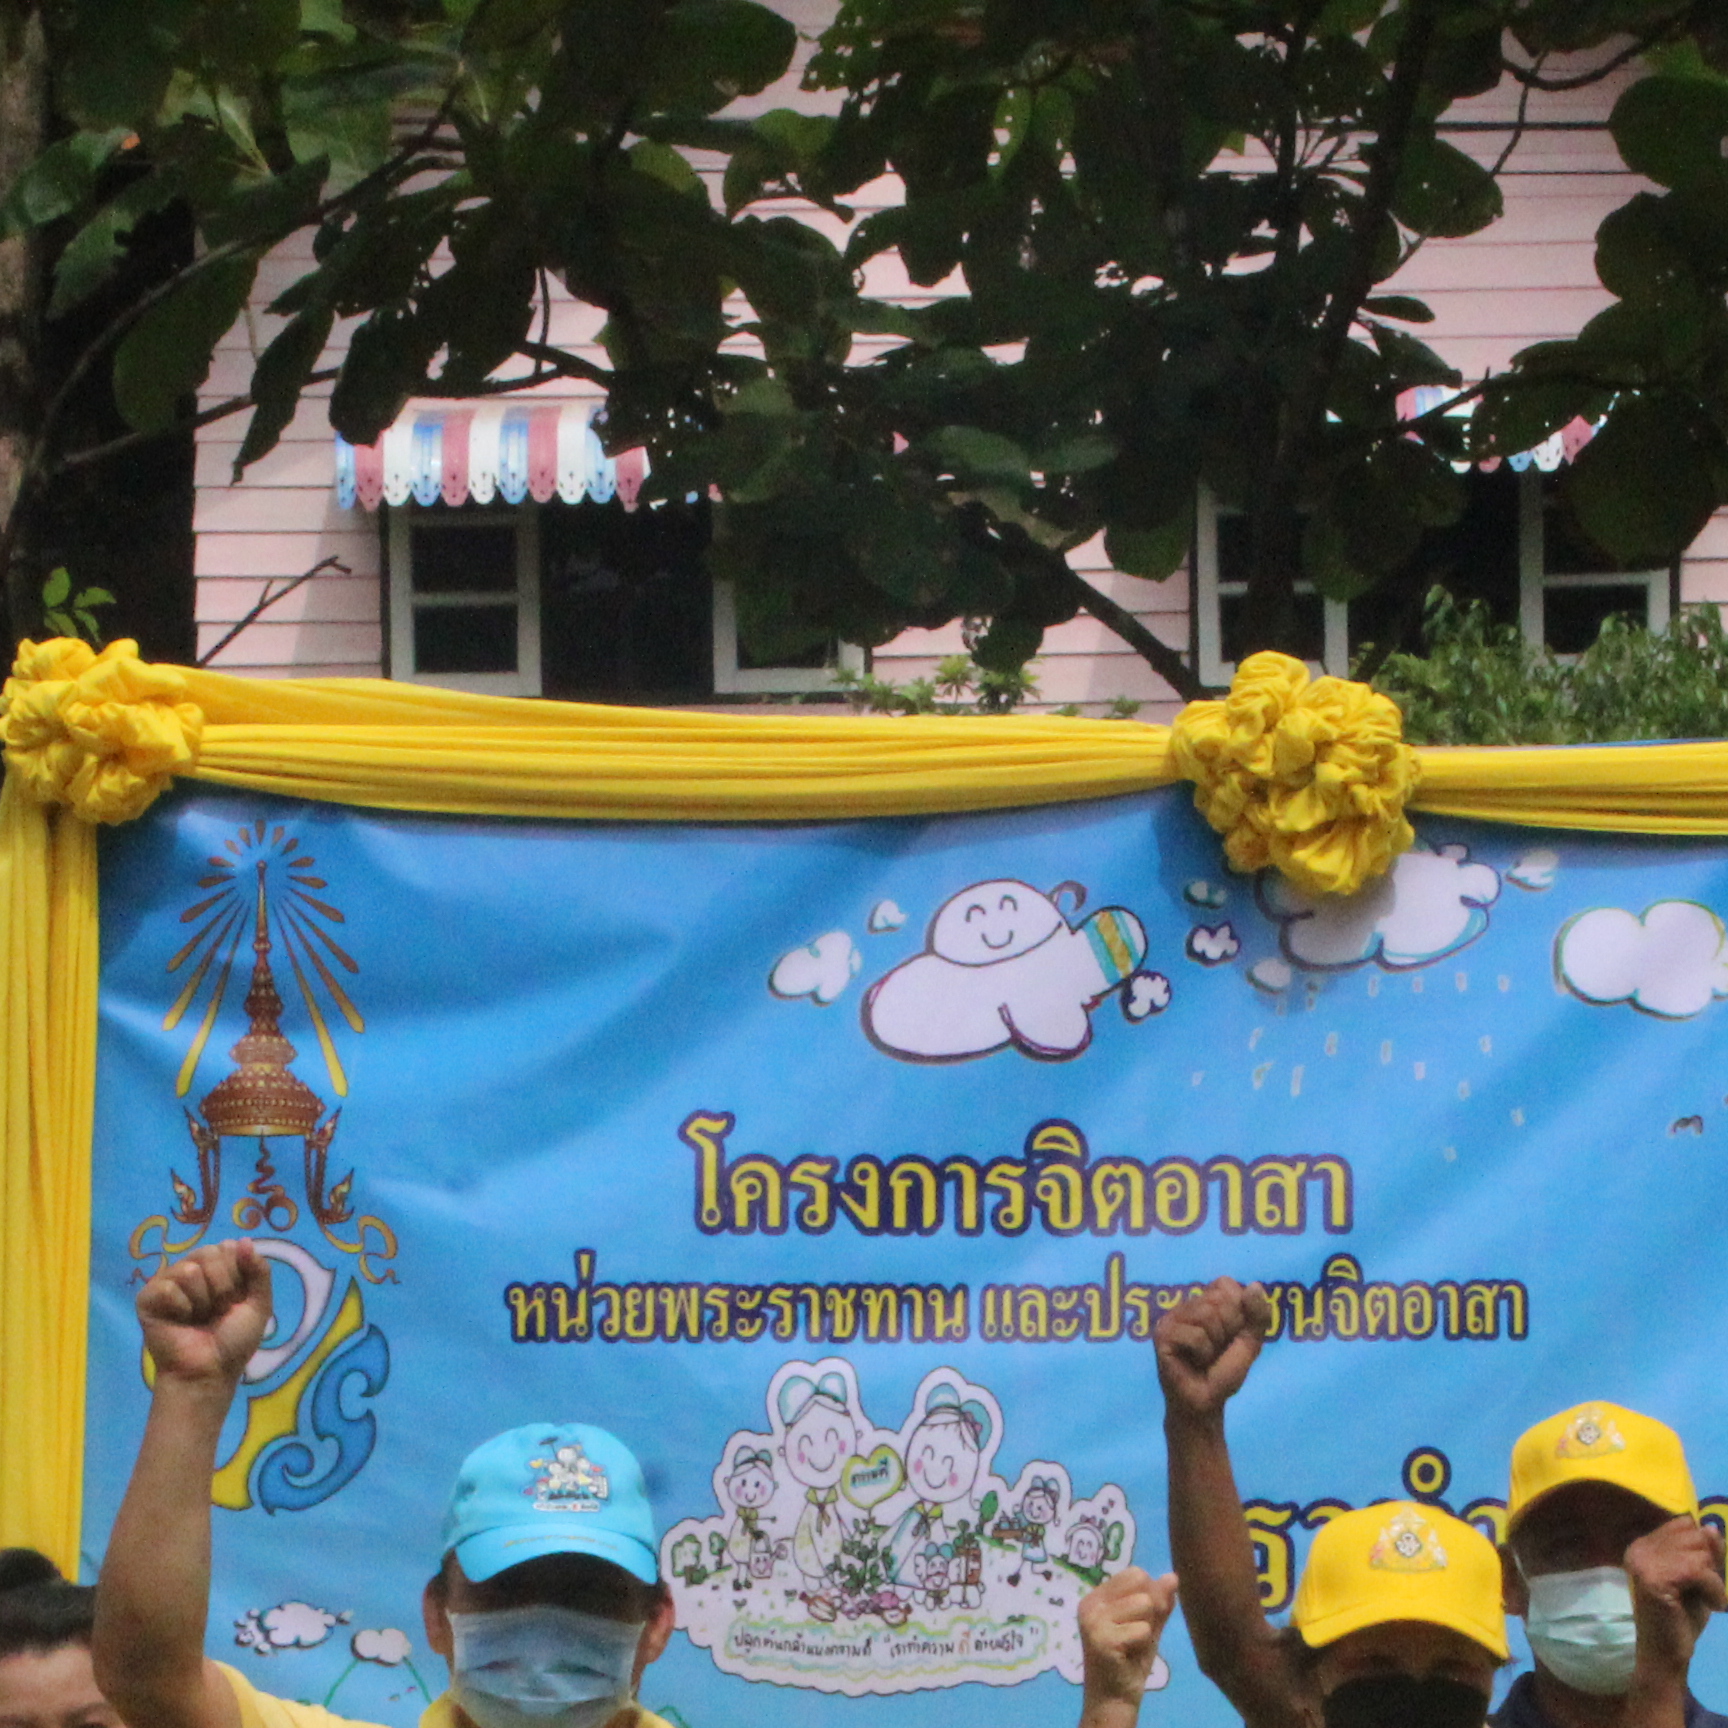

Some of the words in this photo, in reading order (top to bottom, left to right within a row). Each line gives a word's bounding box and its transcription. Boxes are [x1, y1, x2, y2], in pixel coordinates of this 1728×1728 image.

[679, 1111, 1355, 1239] โครงการจิตอาสา
[503, 1249, 969, 1346] หน่วยพระราชทาน
